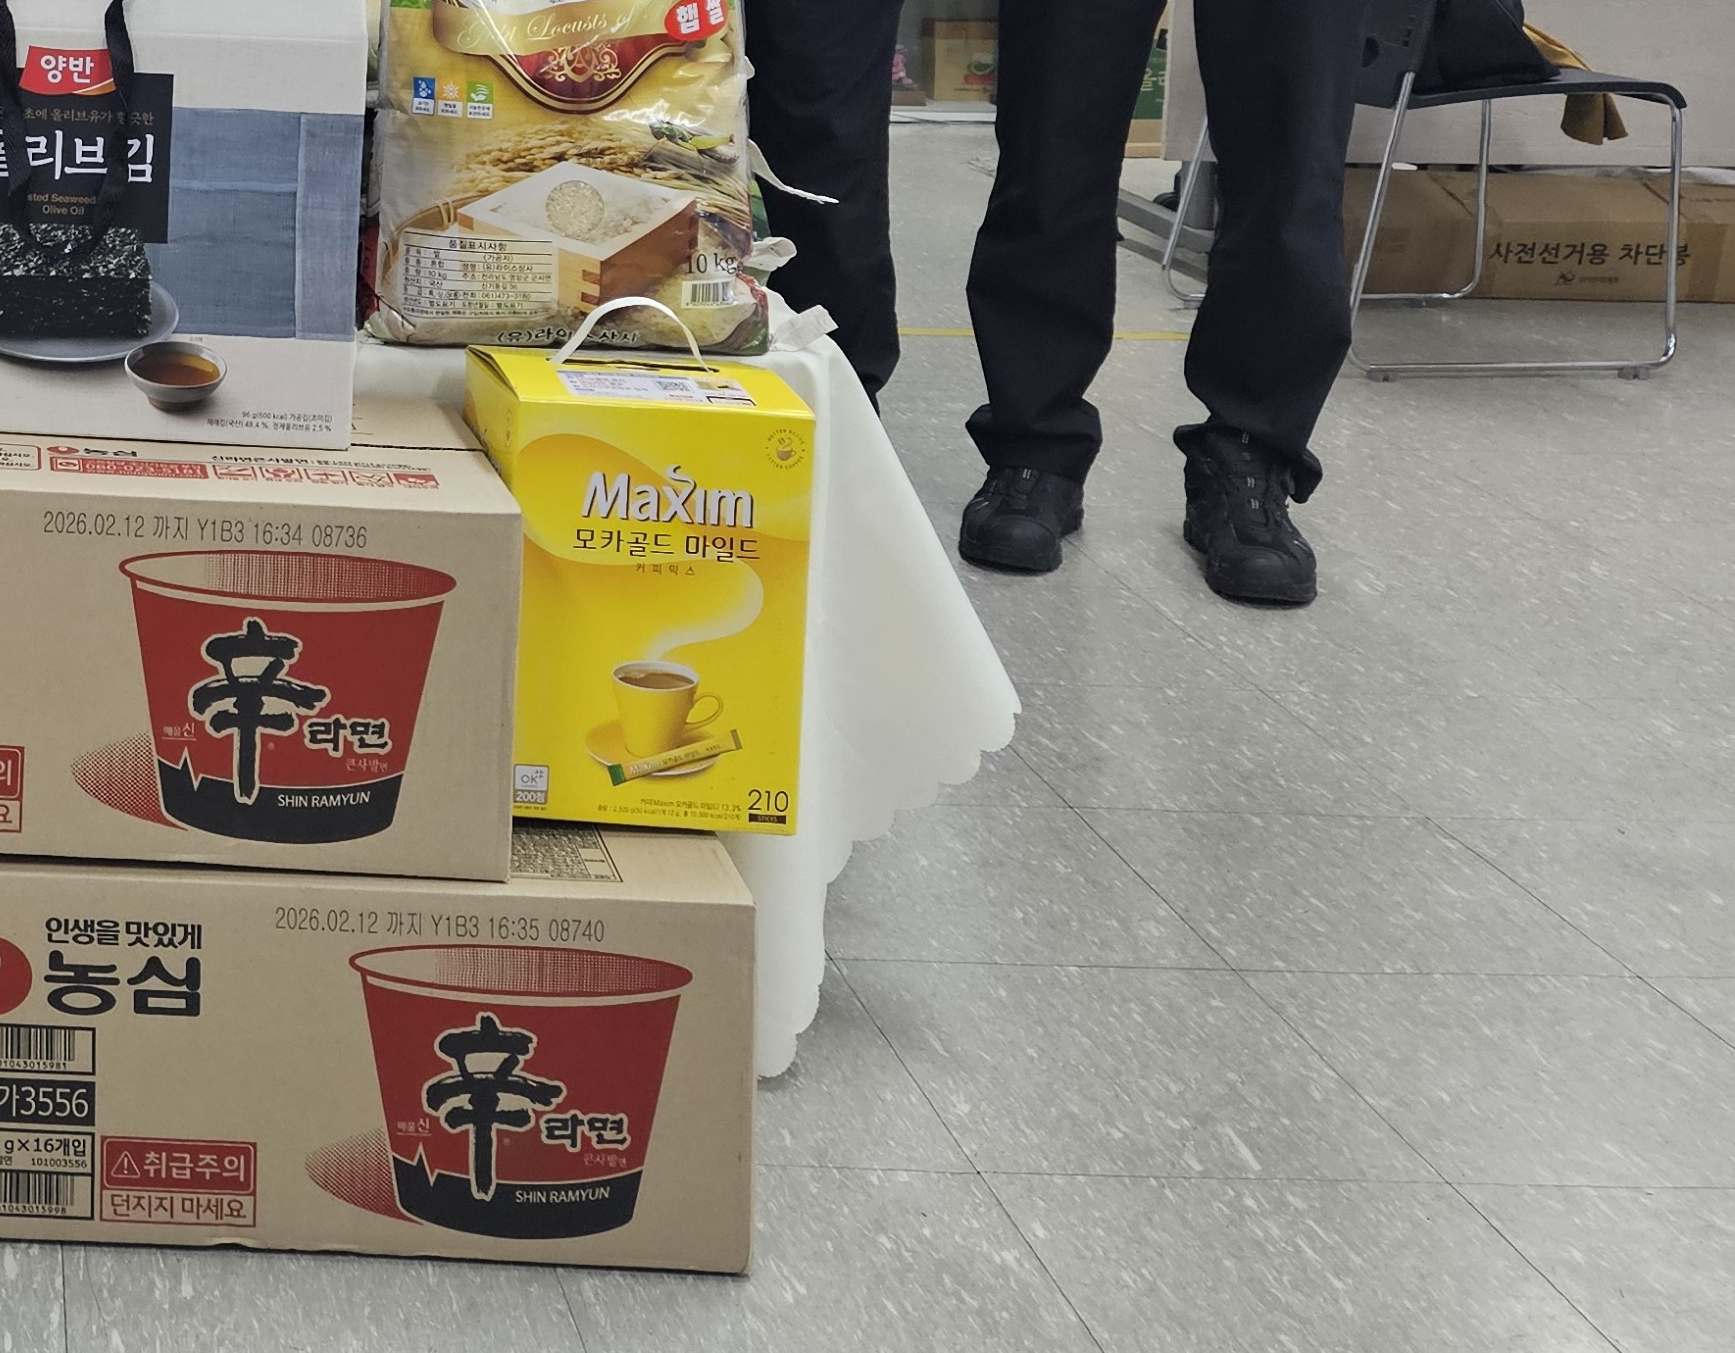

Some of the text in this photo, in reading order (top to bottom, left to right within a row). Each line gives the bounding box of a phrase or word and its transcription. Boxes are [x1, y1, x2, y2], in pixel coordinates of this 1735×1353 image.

[40, 55, 94, 83] 양반
[42, 206, 84, 215] Olive Oil
[51, 193, 96, 205] Seaweed
[686, 253, 738, 274] 10 kg
[1489, 241, 1610, 266] 사전선거용
[581, 465, 755, 529] Maxim
[43, 511, 367, 549] 2026.02.12 까지 Y1B3 16:34 08736
[573, 527, 761, 563] 모카골드 마일드
[190, 618, 329, 803] 辛
[305, 716, 391, 756] 라면
[277, 791, 370, 808] SHIN RAMYUN
[748, 789, 789, 813] 210
[45, 917, 202, 950] 인생을 맛있게
[274, 906, 605, 944] 2026.02.12 까지 Y1B3 16:35 08740
[43, 950, 201, 1017] 농심
[423, 1014, 566, 1199] 辛
[543, 1112, 629, 1150] 라면
[31, 1157, 88, 1169] 101003556
[144, 1151, 245, 1182] 취급주의
[110, 1193, 247, 1221] 던지지 마세요
[516, 1186, 610, 1203] SHIN RAMYUN
